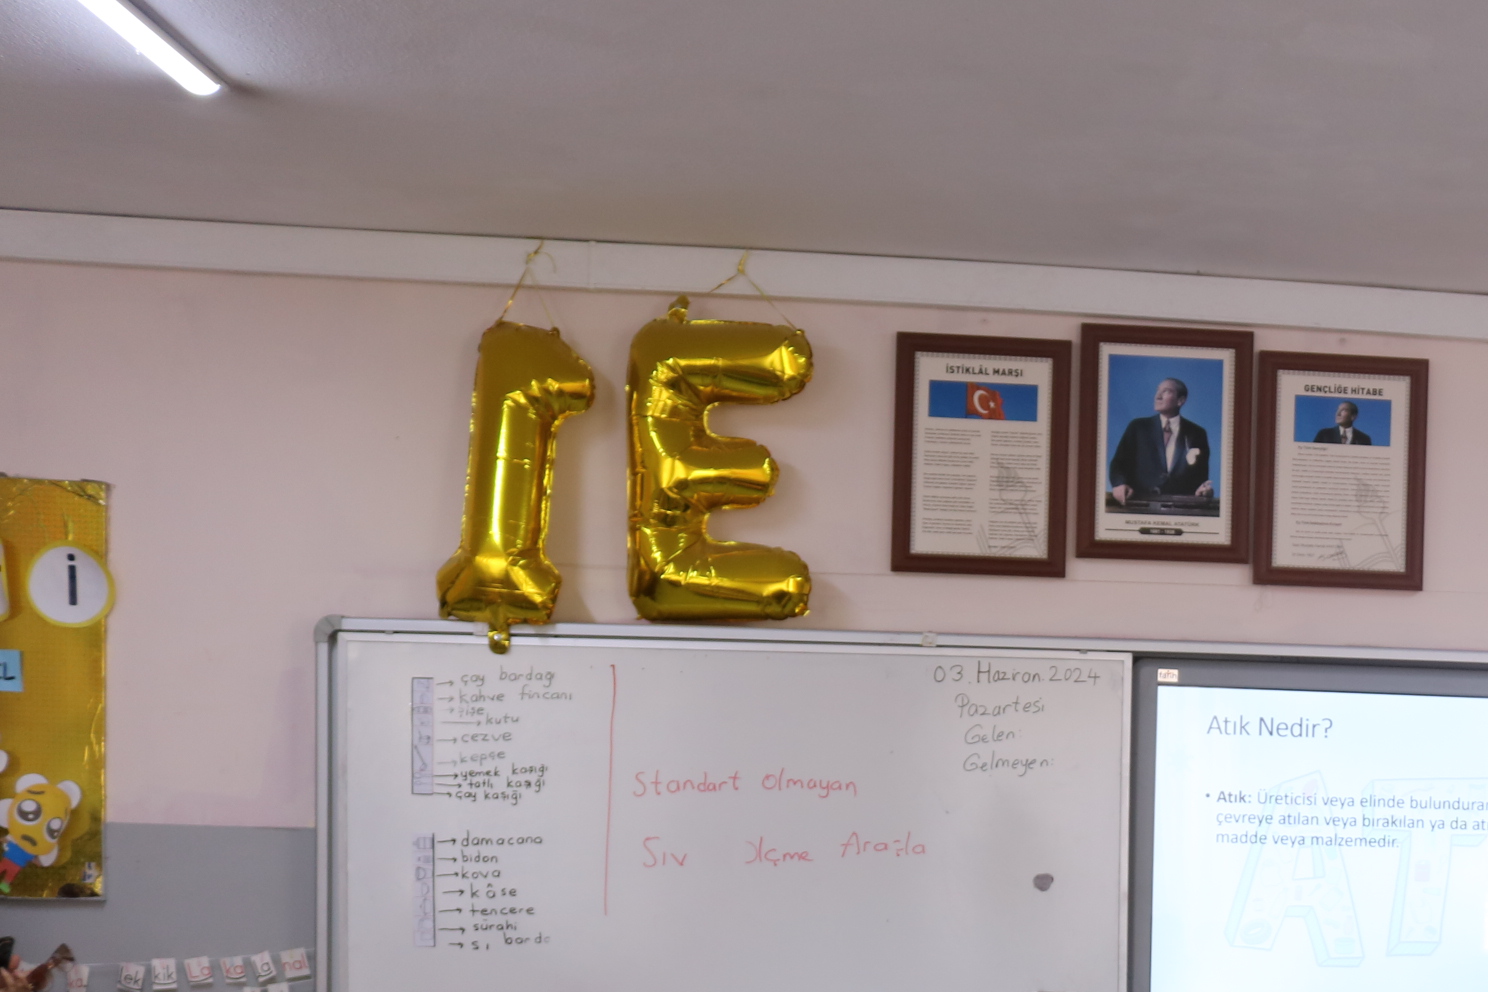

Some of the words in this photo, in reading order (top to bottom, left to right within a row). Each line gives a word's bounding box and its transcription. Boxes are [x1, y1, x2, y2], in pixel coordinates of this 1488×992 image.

[993, 368, 1023, 377] MARŞI
[1351, 386, 1384, 396] HİTABE
[461, 673, 484, 685] çay
[459, 691, 504, 702] kahve
[518, 684, 572, 701] fincanı
[954, 693, 1045, 719] Pazartesi
[486, 714, 519, 725] kutu
[1207, 715, 1250, 735] Atık
[1259, 717, 1333, 738] Nedir?
[461, 732, 512, 743] cezve
[460, 751, 505, 766] kepçe
[461, 767, 500, 781] yemek
[468, 779, 493, 788] tatlı
[633, 769, 739, 798] Standart
[762, 768, 856, 799] Olmayan
[456, 791, 476, 802] çay
[1217, 791, 1251, 804] Atık:
[1258, 789, 1317, 805] Üreticisi
[1322, 795, 1354, 809] veya
[1360, 794, 1404, 809] elinde
[1216, 812, 1273, 826] çevreye
[1278, 812, 1319, 825] atılan
[1324, 816, 1357, 828] veya
[1363, 813, 1423, 828] bırakılan
[1430, 819, 1445, 832] ya
[1450, 817, 1467, 830] da
[461, 830, 542, 847] damacana
[1216, 831, 1267, 844] madde
[1272, 834, 1305, 847] veya
[1311, 834, 1399, 848] malzemedir.
[461, 850, 498, 863] bidon
[462, 867, 500, 879] kova
[470, 904, 534, 916] tencere
[473, 918, 516, 931] sürahi
[153, 966, 175, 980] kik
[224, 963, 244, 978] ka
